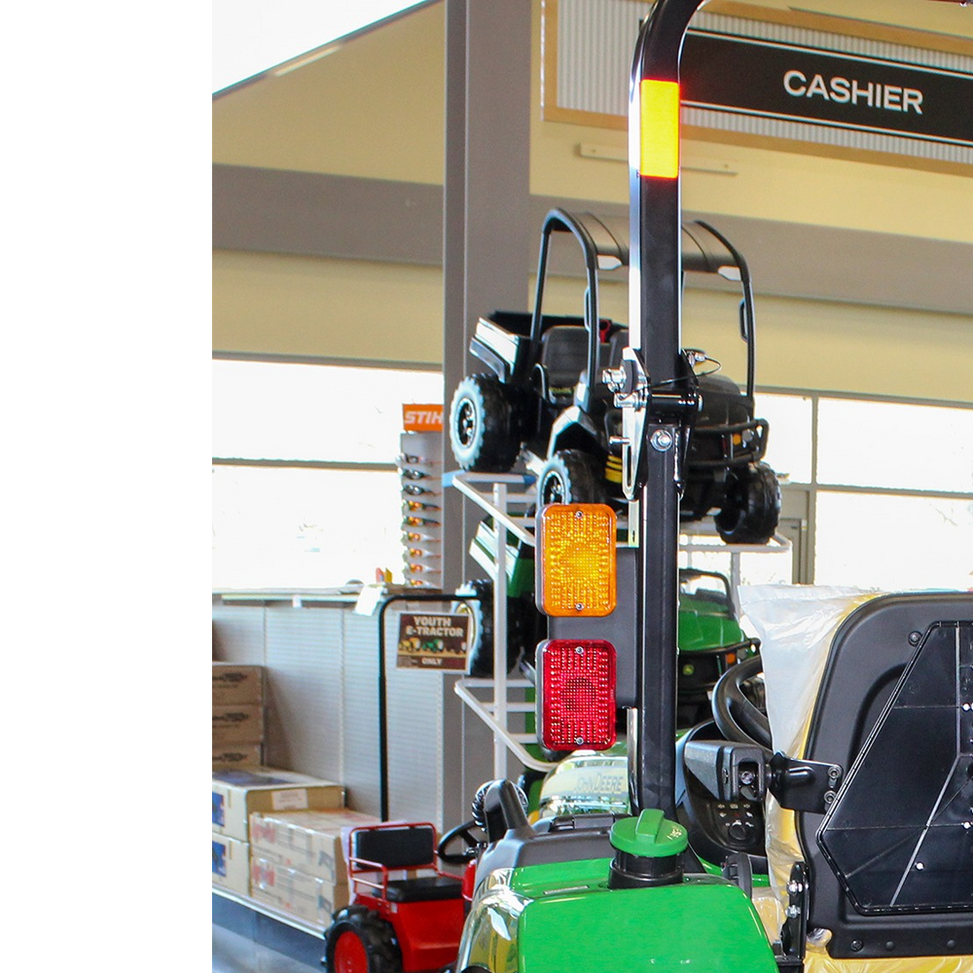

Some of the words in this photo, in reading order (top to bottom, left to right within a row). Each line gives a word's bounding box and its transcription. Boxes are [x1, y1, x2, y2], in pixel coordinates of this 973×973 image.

[783, 70, 924, 115] CASHIER
[413, 616, 452, 626] YOUTH
[405, 625, 464, 637] E-TRACTOR
[421, 657, 443, 665] ONLY
